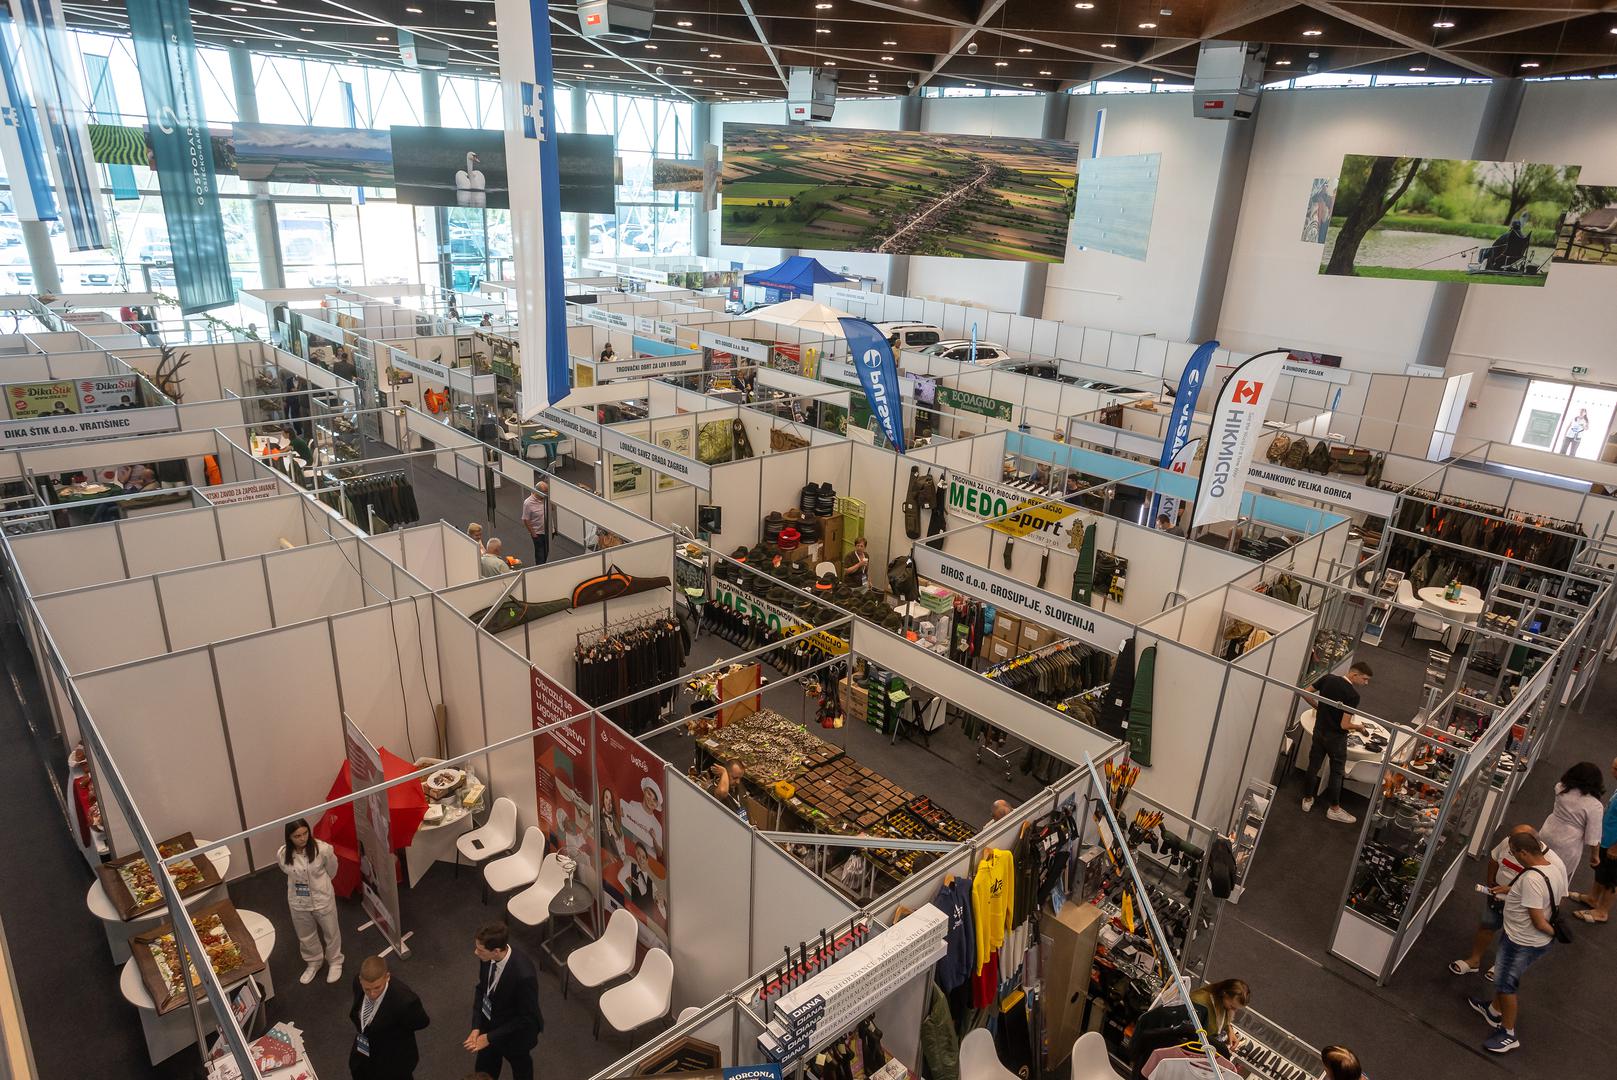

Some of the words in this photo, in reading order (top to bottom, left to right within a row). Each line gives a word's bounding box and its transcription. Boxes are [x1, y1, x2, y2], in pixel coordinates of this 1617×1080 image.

[952, 390, 996, 410] ECOAGRO
[4, 430, 28, 439] DIKA
[30, 426, 50, 436] ŠTIK
[53, 424, 78, 434] d.o.o.
[79, 418, 130, 431] VRATIŠINEC
[619, 441, 637, 455] LOVAČKI
[637, 448, 651, 460] SAVEZ
[651, 454, 666, 466] GRADA
[667, 460, 689, 475] ZAGREBA
[1210, 410, 1244, 498] HIKMICRO
[952, 474, 976, 488] TRGOVINA
[977, 482, 984, 490] ZA
[996, 488, 1020, 501] RIBOLOV
[1298, 480, 1322, 493] VELIKA
[1324, 486, 1352, 500] GORICA
[949, 482, 1008, 522] MEDO
[716, 581, 743, 597] TRGOVINA
[767, 604, 792, 622] RIBOLOV
[940, 564, 964, 582] BIROS
[966, 575, 988, 592] d.o.o.
[990, 583, 1042, 614] GROSUPLJE,
[1044, 604, 1095, 634] SLOVENIJA
[535, 676, 563, 708] Obrazuj
[563, 700, 573, 712] se
[825, 958, 875, 997] PERFORMANCE
[879, 938, 906, 961] AIRGUNS
[908, 925, 925, 942] SINCE
[792, 997, 822, 1018] DIANA
[796, 1004, 825, 1026] DIANA
[795, 1015, 823, 1037] DIANA
[786, 1029, 816, 1051] DIANA
[781, 1044, 806, 1064] DIANA
